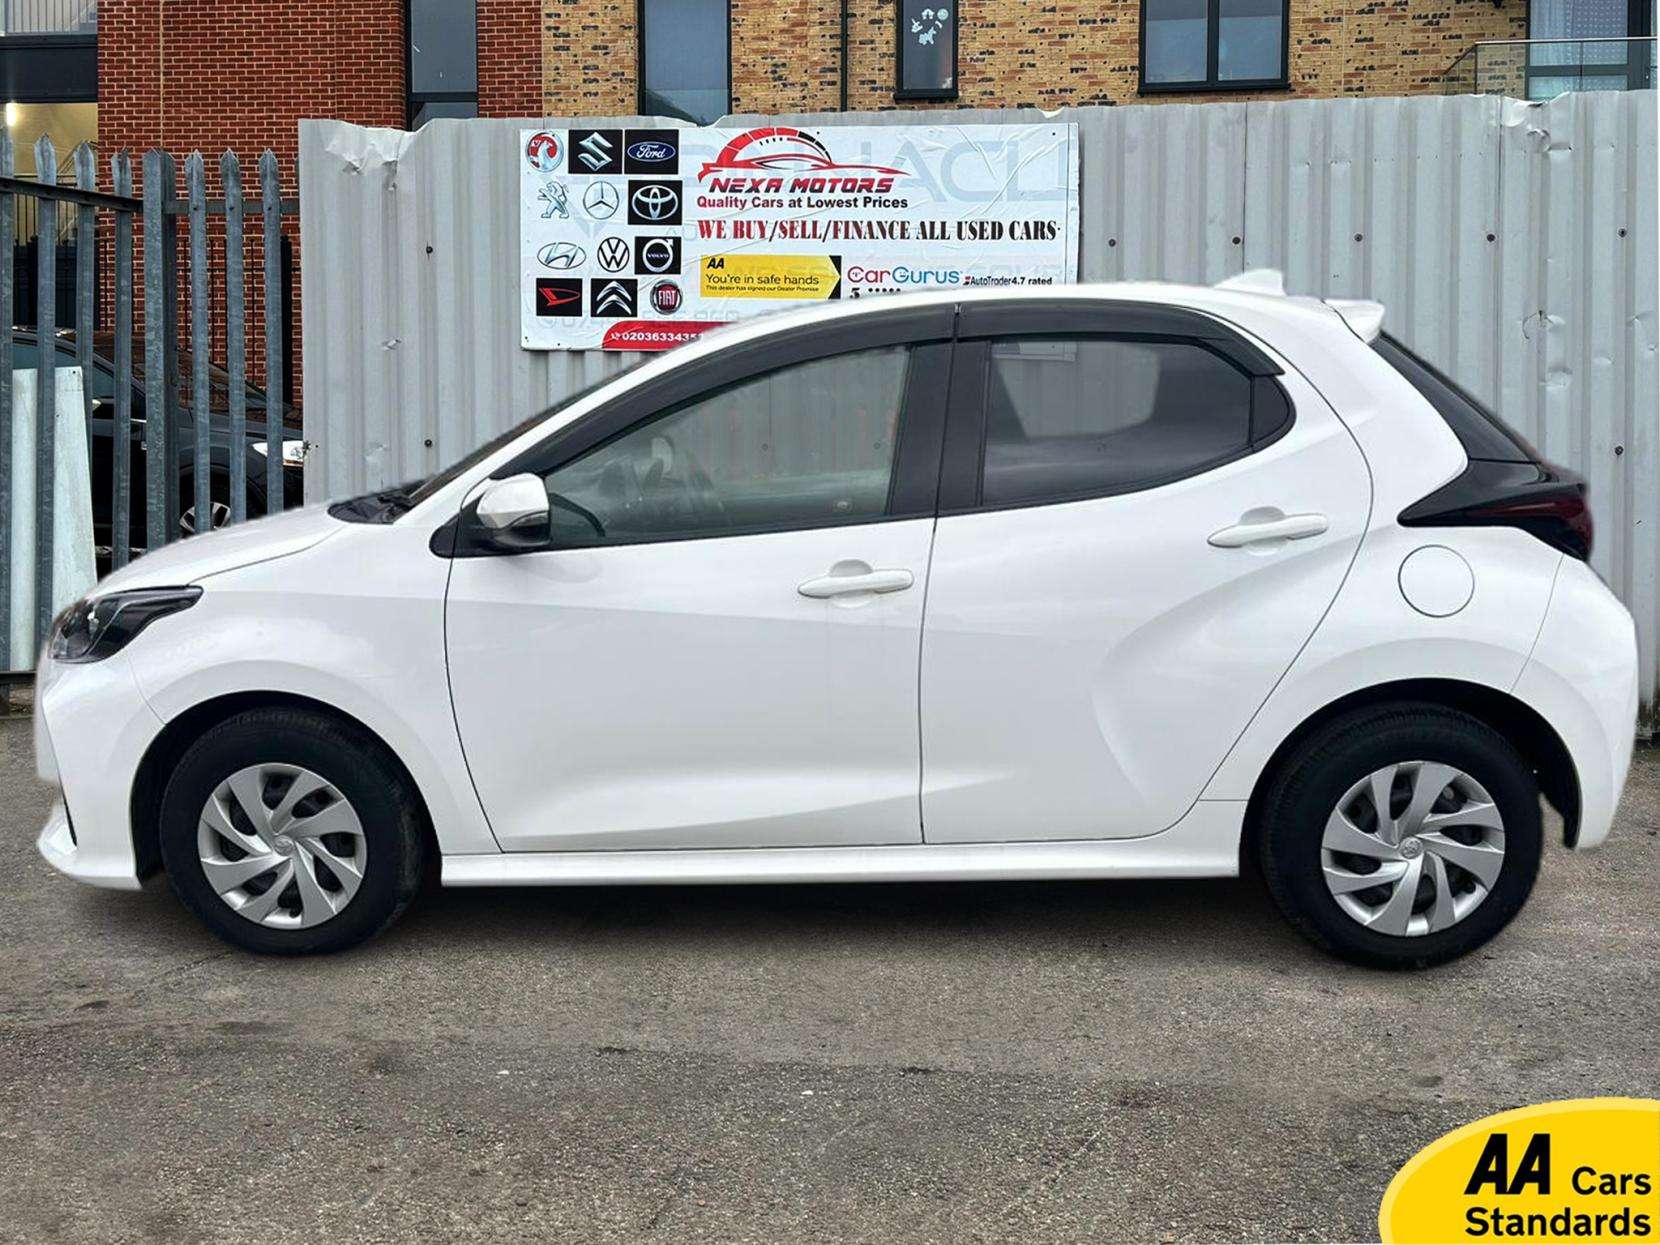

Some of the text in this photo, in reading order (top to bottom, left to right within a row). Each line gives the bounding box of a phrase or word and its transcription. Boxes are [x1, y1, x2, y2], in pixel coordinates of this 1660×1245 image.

[636, 144, 666, 159] Ford
[709, 178, 895, 193] NEXA MOTORS
[697, 196, 908, 211] Quality Cars at Lowest Prices
[697, 220, 726, 239] WE
[916, 220, 951, 240] ALL
[956, 220, 1004, 241] USED
[1008, 220, 1057, 241] CARS
[707, 258, 725, 269] AA
[706, 274, 819, 285] You're in safe hands
[848, 266, 960, 284] CarGurus
[1028, 277, 1053, 285] rated
[658, 290, 676, 305] FIAT
